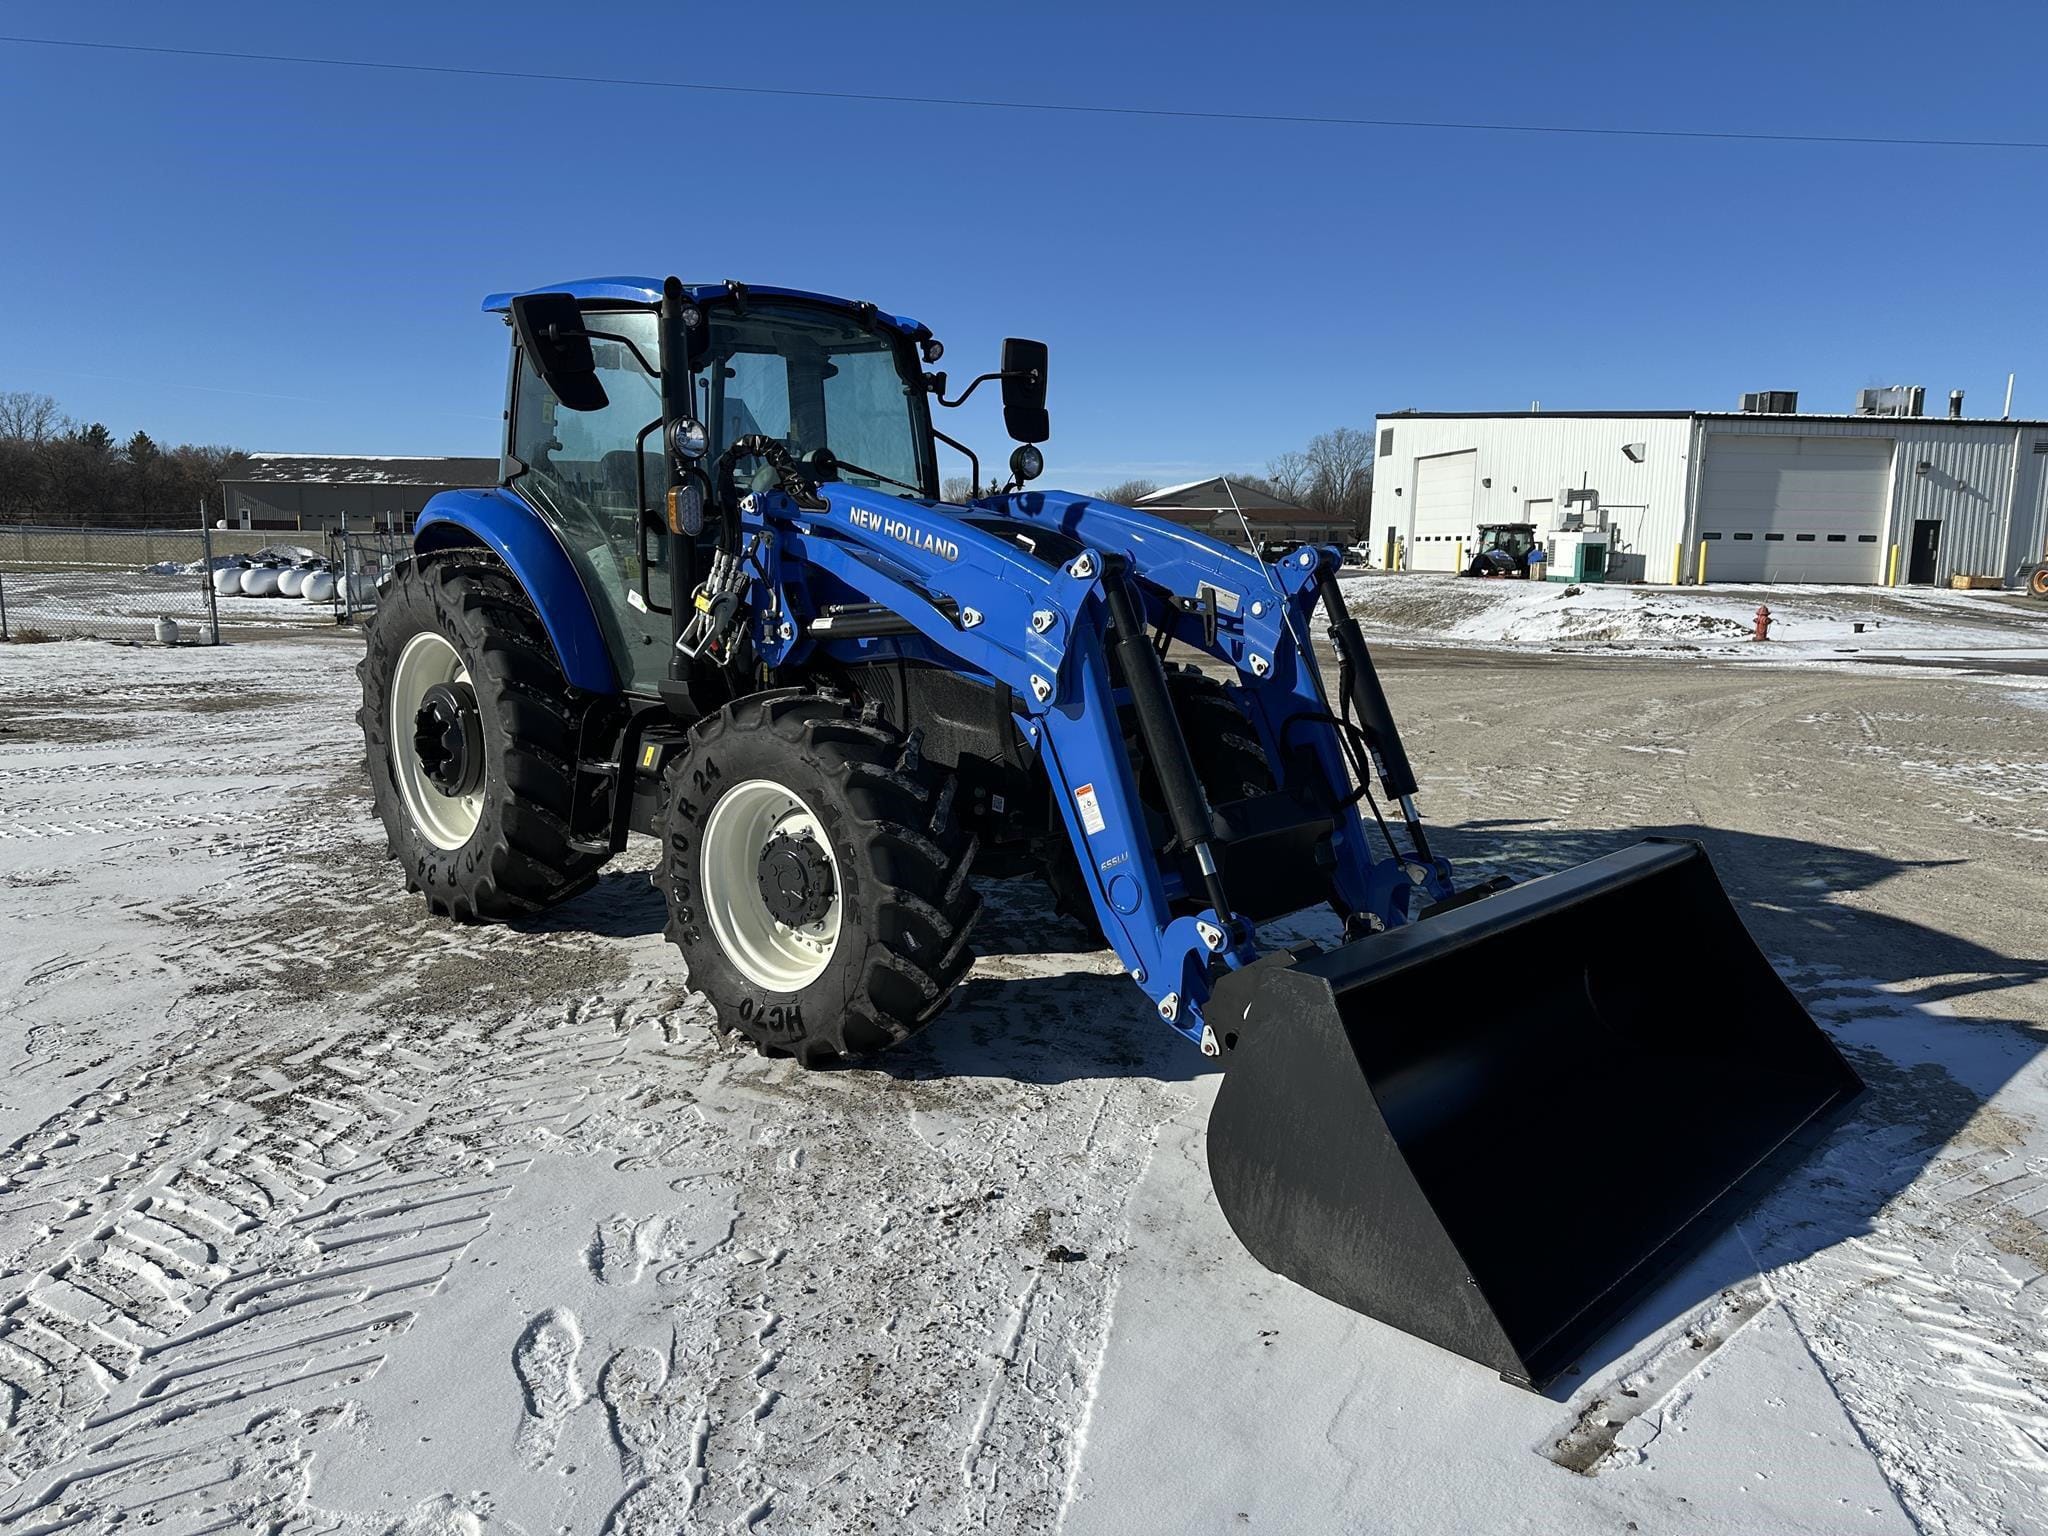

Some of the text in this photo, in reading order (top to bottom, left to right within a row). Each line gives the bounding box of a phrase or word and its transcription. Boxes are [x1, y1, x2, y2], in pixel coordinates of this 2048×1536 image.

[849, 506, 959, 562] NEW HOLLAND
[677, 796, 699, 823] R
[692, 756, 722, 796] 24
[417, 857, 437, 887] 34
[447, 864, 458, 887] R
[738, 998, 807, 1039] HC70
